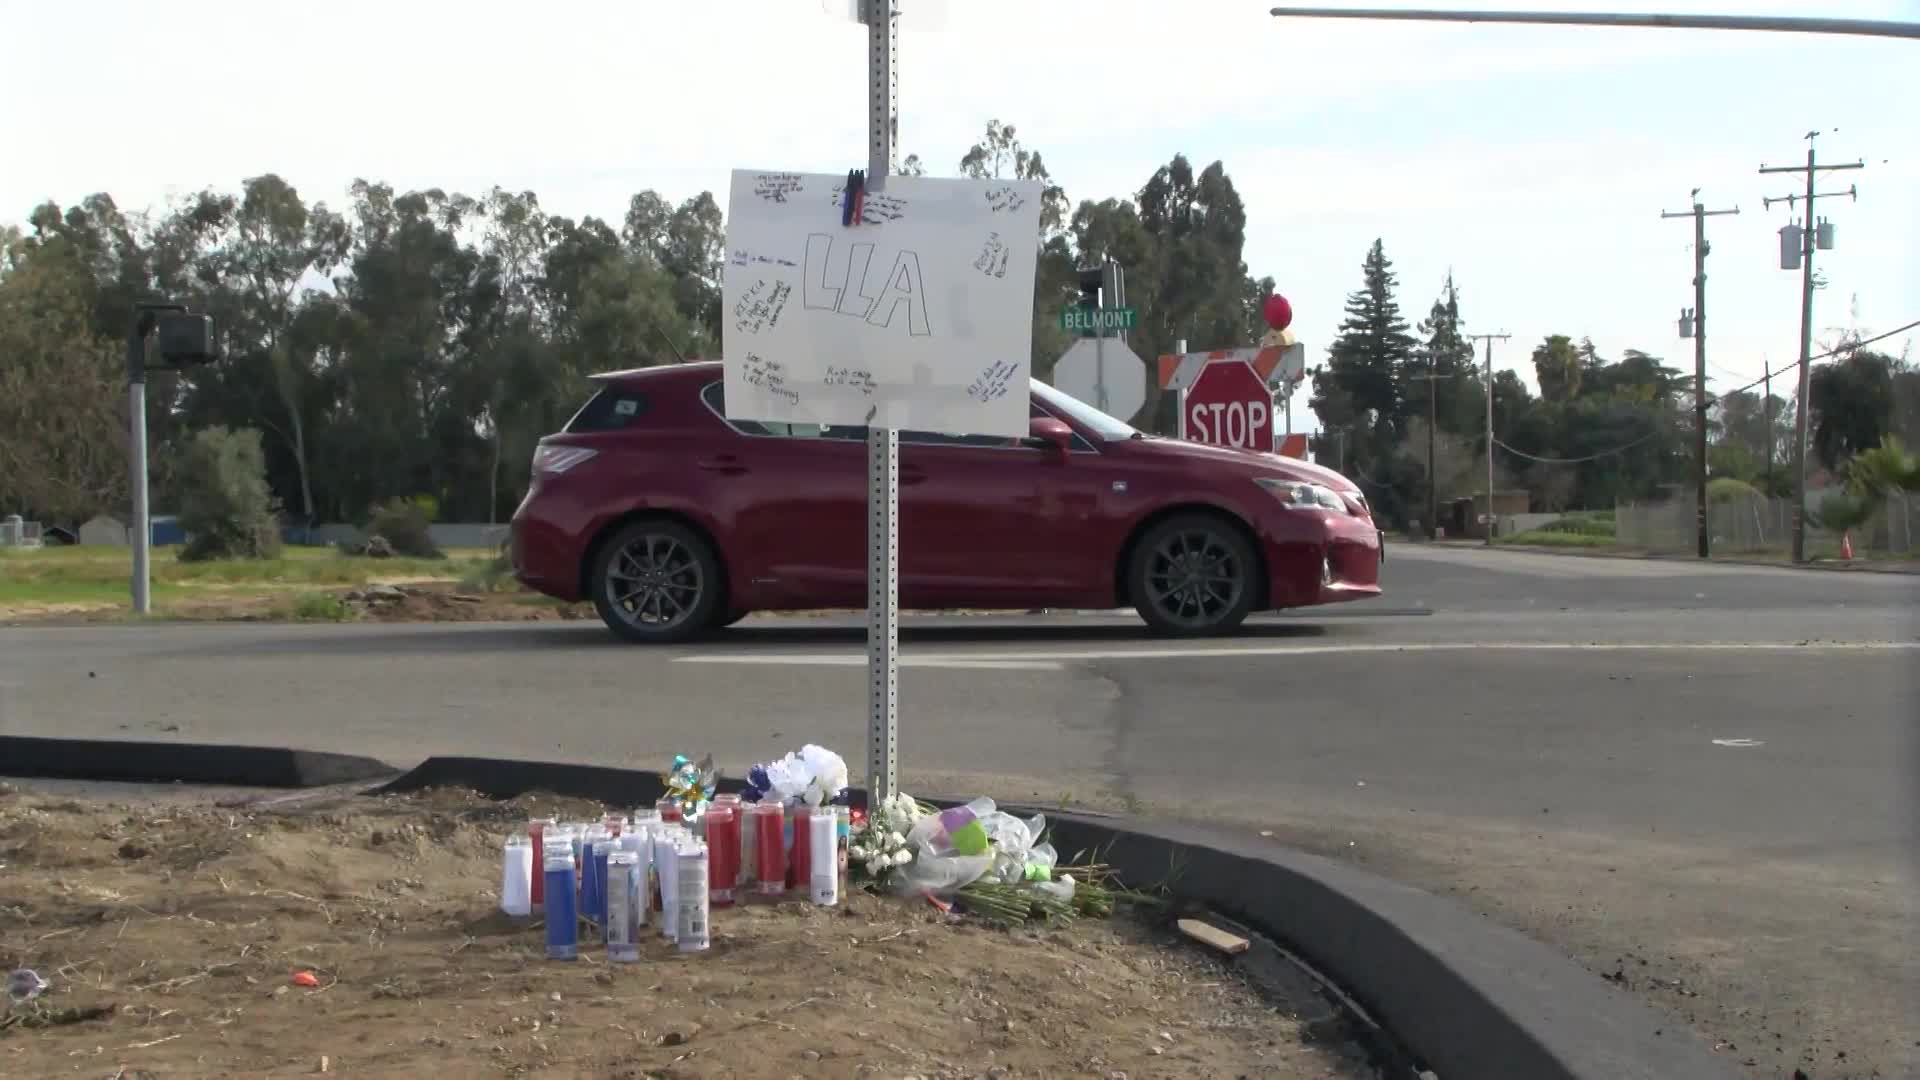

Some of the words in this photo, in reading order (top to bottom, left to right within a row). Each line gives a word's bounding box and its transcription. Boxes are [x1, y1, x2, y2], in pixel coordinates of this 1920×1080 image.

[803, 233, 931, 337] LLA
[1064, 311, 1133, 329] BELMONT
[1191, 401, 1267, 448] STOP
